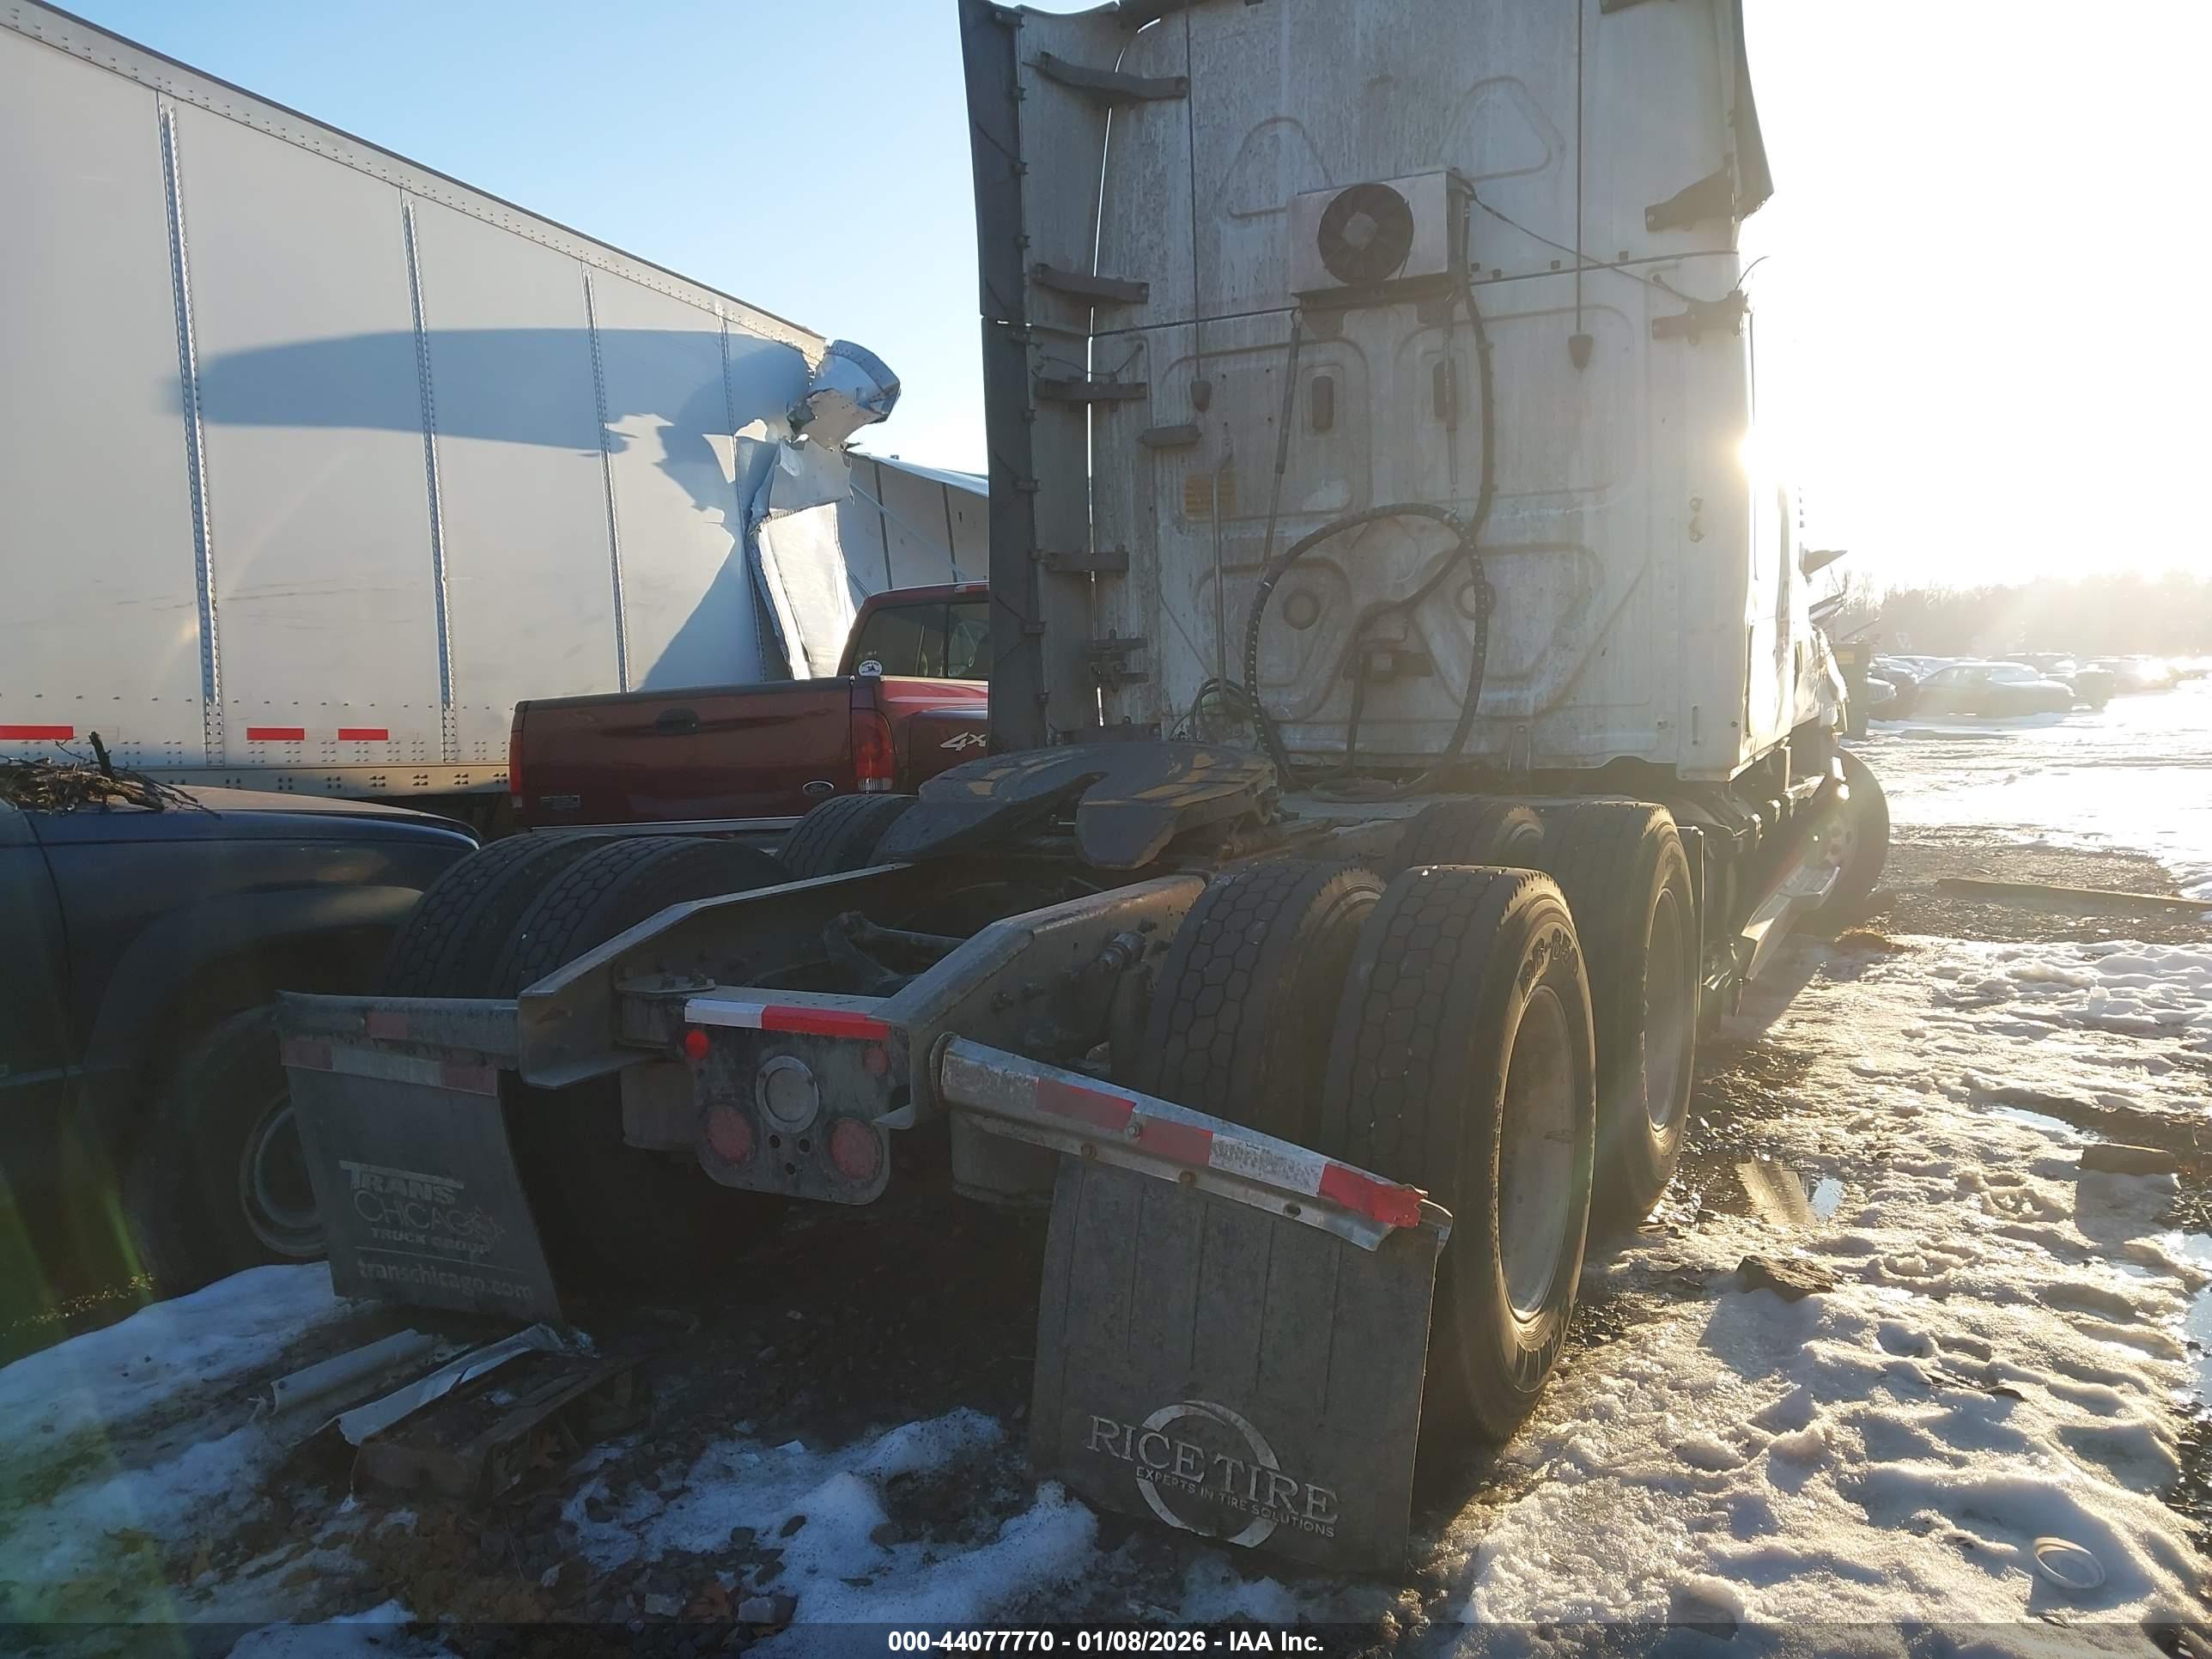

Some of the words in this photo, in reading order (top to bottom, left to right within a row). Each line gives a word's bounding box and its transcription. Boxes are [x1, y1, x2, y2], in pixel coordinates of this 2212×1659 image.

[338, 1159, 465, 1205] TRANS
[371, 1227, 427, 1245] TRUCK
[1086, 1414, 1206, 1484] RICE
[1213, 1453, 1340, 1525] TIRE
[1136, 1466, 1196, 1494] EXPERTS
[1200, 1486, 1215, 1501] IN
[1218, 1492, 1248, 1512] TIRE
[1250, 1504, 1335, 1539] SOLUTIONS
